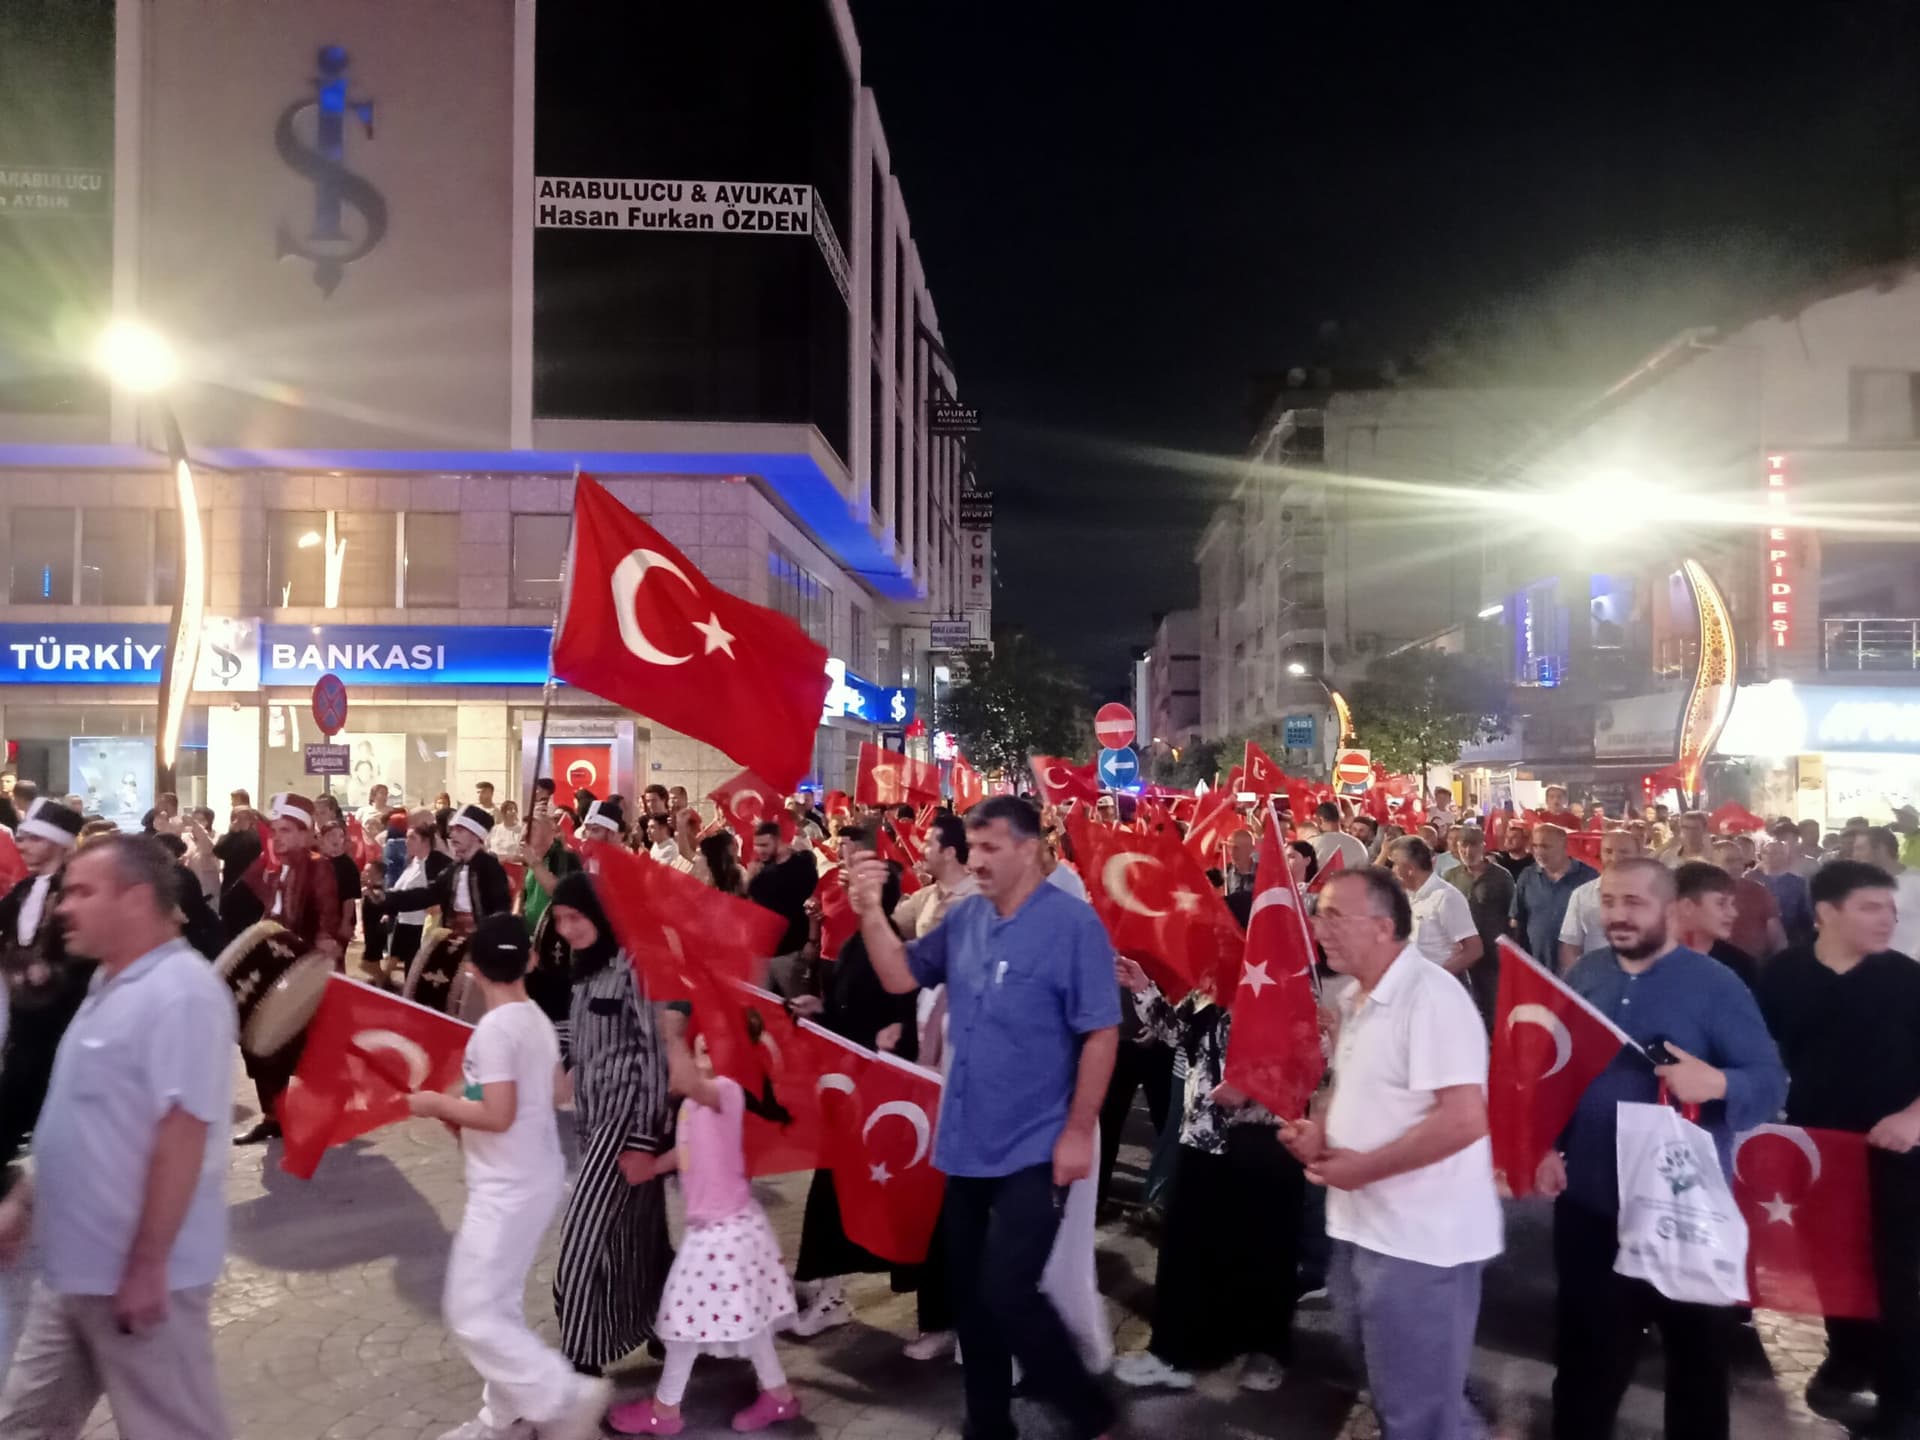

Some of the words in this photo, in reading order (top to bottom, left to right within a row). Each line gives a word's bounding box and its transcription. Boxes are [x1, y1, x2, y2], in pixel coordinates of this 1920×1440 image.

[540, 180, 683, 201] ARABULUCU
[691, 184, 707, 203] &
[715, 185, 807, 205] AVUKAT
[540, 204, 619, 226] Hasan
[628, 206, 713, 229] Furkan
[722, 203, 808, 232] ÖZDEN
[936, 409, 978, 418] AVUKAT
[961, 510, 993, 518] AVUKAT
[970, 533, 985, 590] CHP
[10, 636, 167, 671] TÜRKİY
[272, 643, 446, 671] BANKASI
